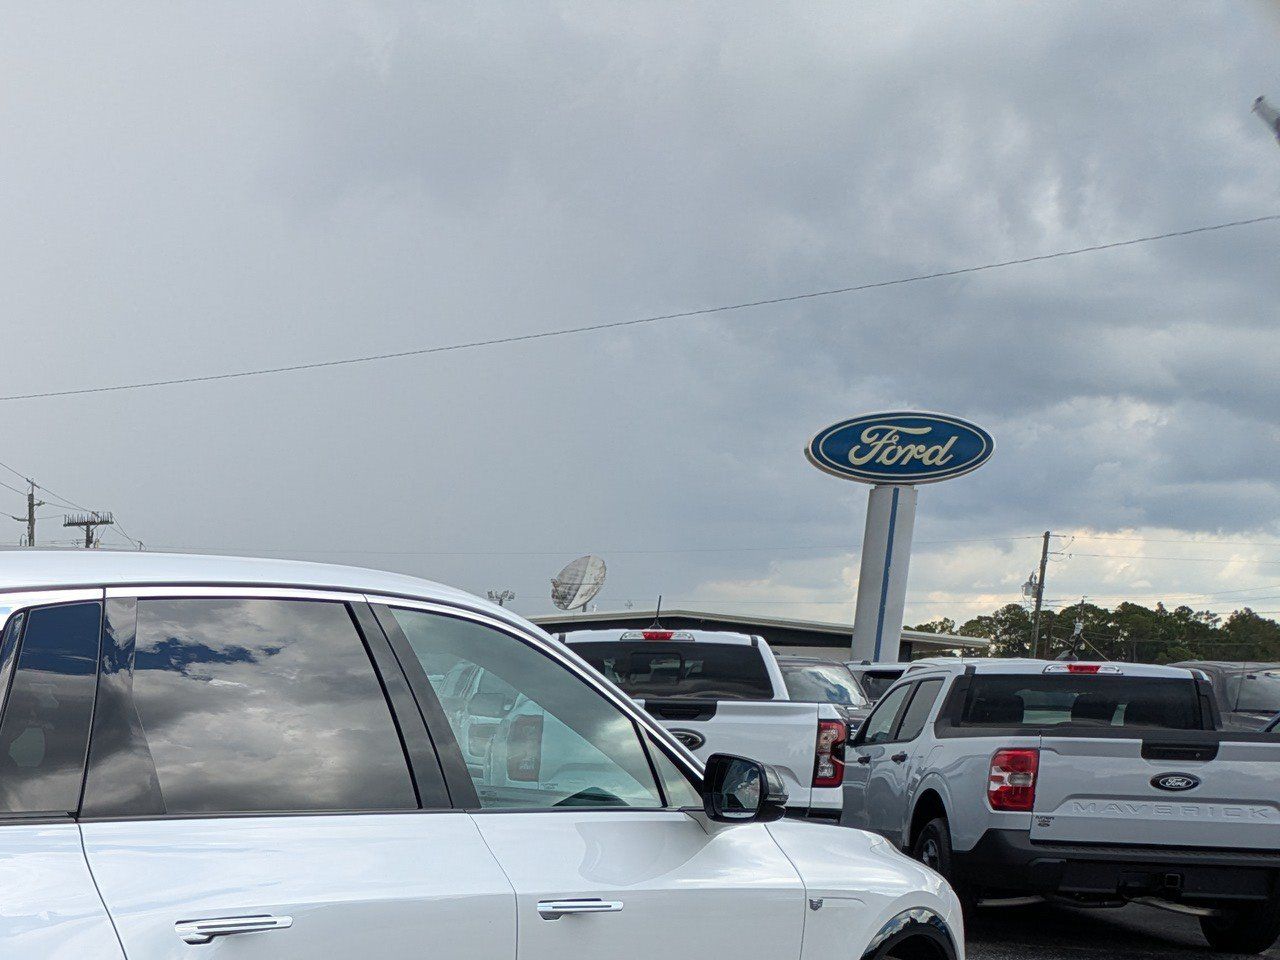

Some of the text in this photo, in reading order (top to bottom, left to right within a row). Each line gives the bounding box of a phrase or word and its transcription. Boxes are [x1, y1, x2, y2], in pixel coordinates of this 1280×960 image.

[848, 425, 959, 466] Ford
[1166, 778, 1187, 787] Ford
[1072, 802, 1269, 819] MAVERICK
